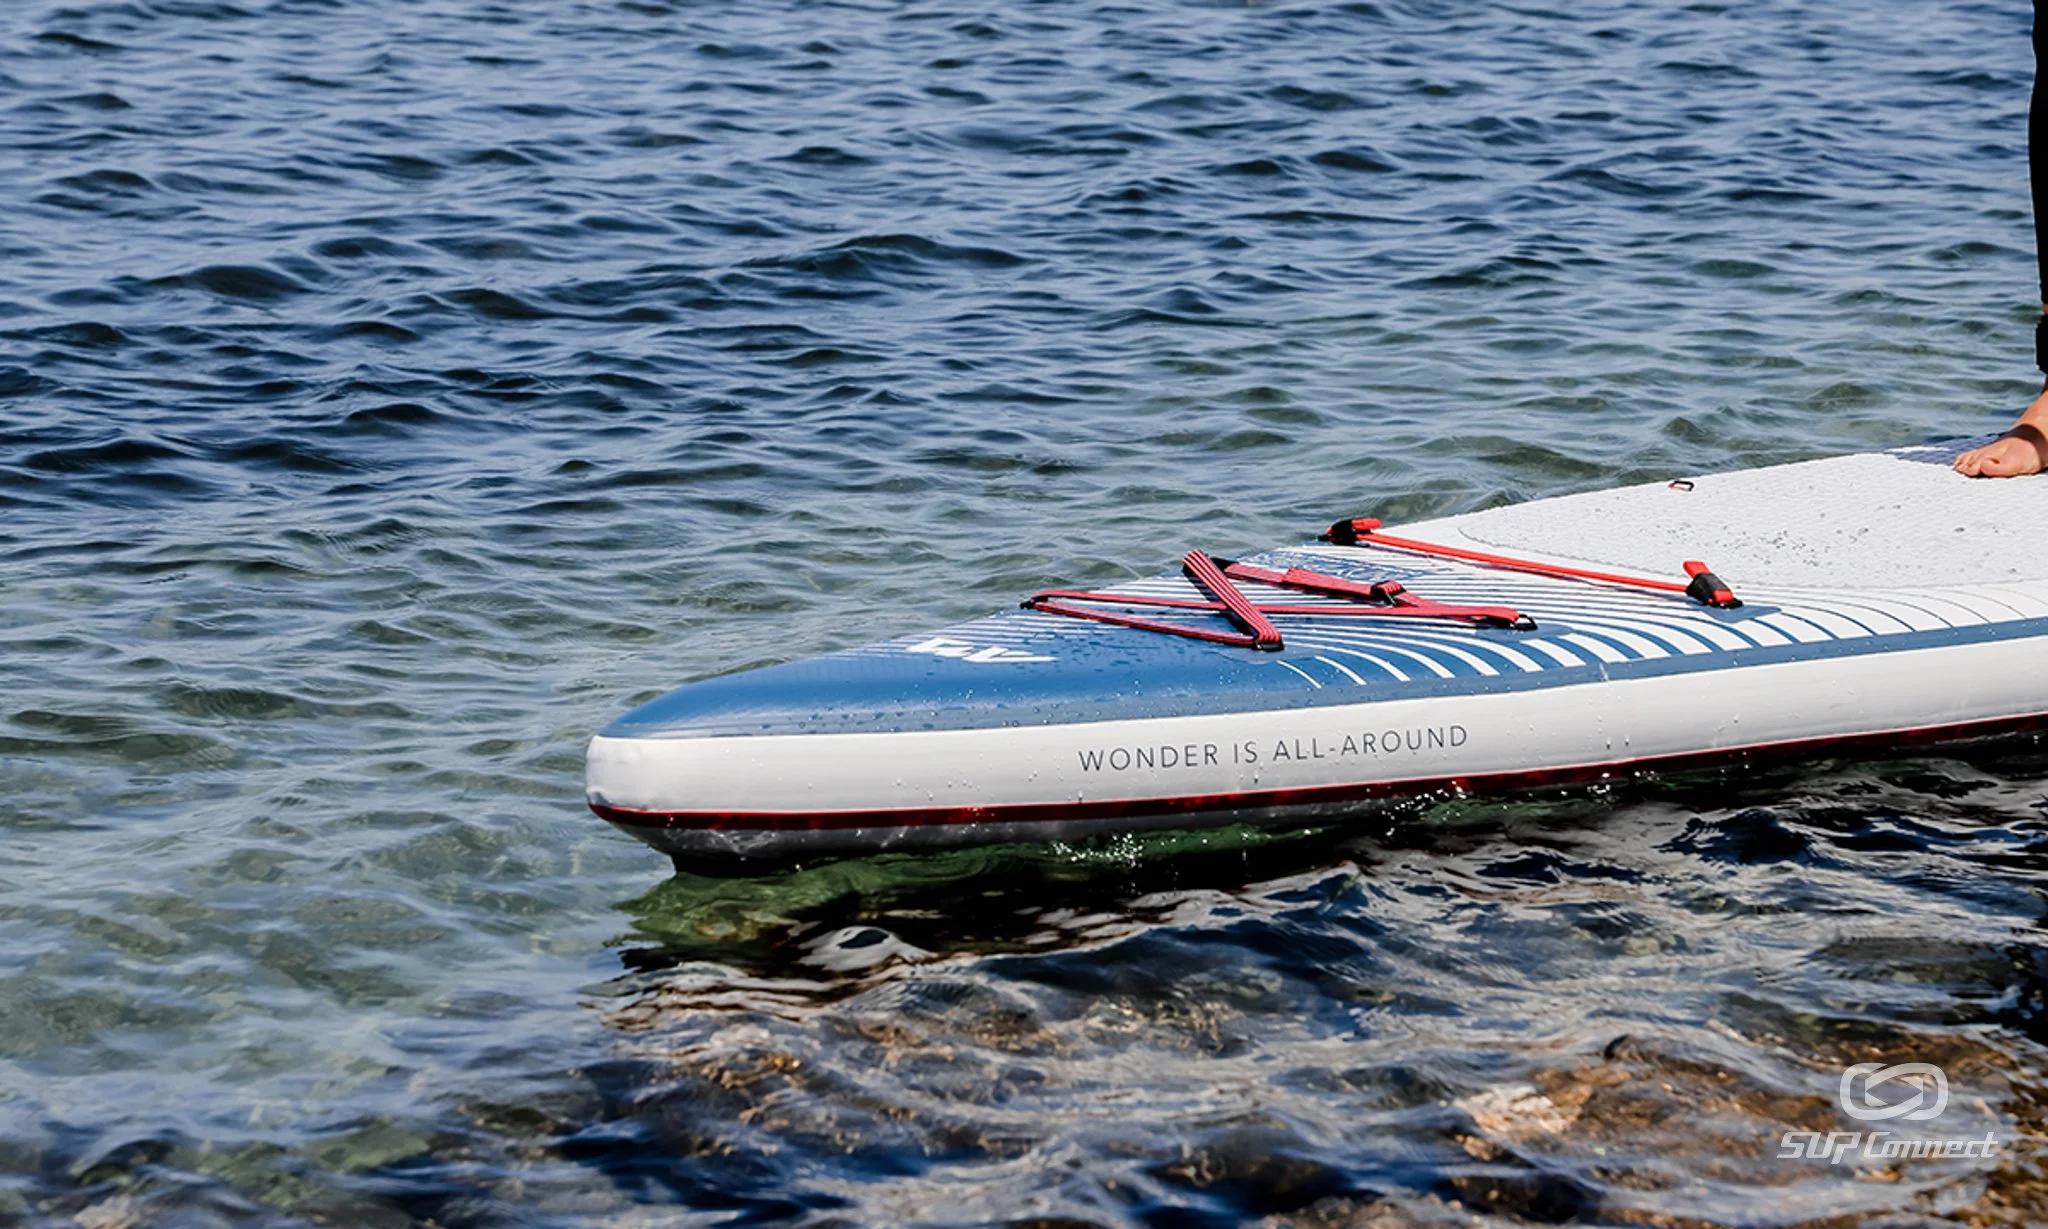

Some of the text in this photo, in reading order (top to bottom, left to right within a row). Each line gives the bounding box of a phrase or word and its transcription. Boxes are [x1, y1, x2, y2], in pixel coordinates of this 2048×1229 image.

[1078, 724, 1469, 772] WONDER IS ALL-AROUND
